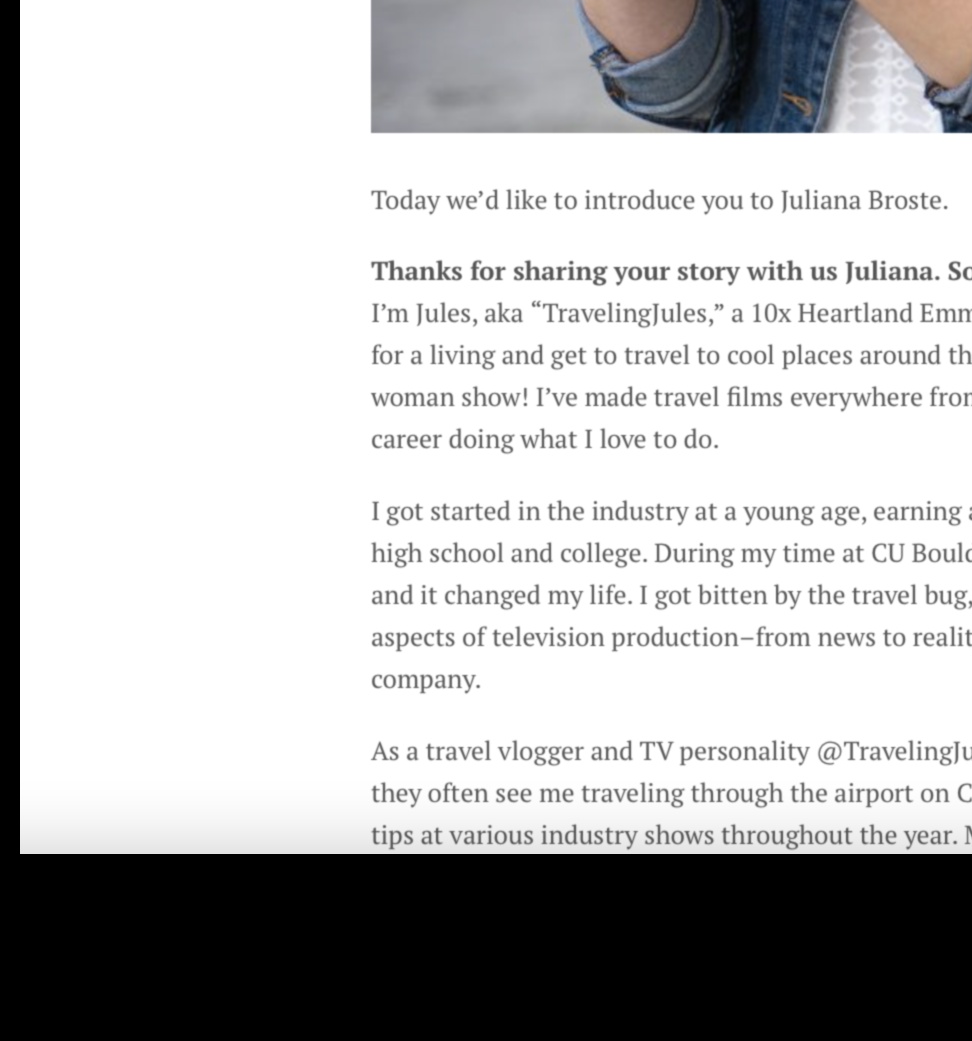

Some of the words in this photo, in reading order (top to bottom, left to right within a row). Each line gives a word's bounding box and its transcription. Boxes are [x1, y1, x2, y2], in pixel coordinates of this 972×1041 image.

[370, 188, 441, 216] Today
[445, 188, 500, 211] we’d
[505, 188, 548, 211] like
[553, 191, 578, 211] to
[584, 188, 696, 211] introduce
[701, 194, 744, 216] you
[749, 191, 774, 211] to
[781, 188, 862, 215] Juliana
[868, 189, 949, 211] Broste.
[370, 259, 463, 282] Thanks
[470, 259, 507, 282] for
[513, 259, 609, 287] sharing
[612, 265, 671, 287] your
[677, 262, 741, 287] story
[746, 259, 804, 282] with
[809, 265, 838, 282] us
[844, 259, 941, 286] Juliana.
[371, 302, 409, 324] I’m
[415, 301, 478, 328] Jules,
[484, 301, 524, 324] aka
[531, 299, 725, 329] “TravelingJules,”
[731, 307, 744, 324] a
[752, 302, 792, 324] 10x
[797, 301, 914, 324] Heartland
[371, 433, 443, 450] career
[448, 427, 516, 455] doing
[519, 427, 578, 450] what
[584, 428, 593, 450] I
[599, 427, 647, 450] love
[653, 430, 678, 450] to
[683, 427, 719, 450] do.
[370, 541, 423, 569] high
[429, 541, 504, 564] school
[510, 541, 554, 564] and
[560, 541, 648, 569] college.
[654, 541, 736, 569] During
[740, 547, 777, 569] my
[782, 541, 836, 564] time
[842, 544, 865, 564] at
[871, 542, 906, 564] CU
[371, 628, 456, 653] aspects
[462, 625, 488, 648] of
[491, 625, 605, 648] television
[611, 625, 812, 653] production–from
[817, 631, 876, 648] news
[882, 628, 907, 648] to
[371, 673, 481, 695] company.
[371, 823, 414, 851] tips
[420, 826, 443, 846] at
[448, 823, 534, 846] various
[541, 823, 639, 851] industry
[644, 823, 715, 846] shows
[721, 823, 853, 851] throughout
[859, 823, 898, 846] the
[903, 829, 958, 851] year.
